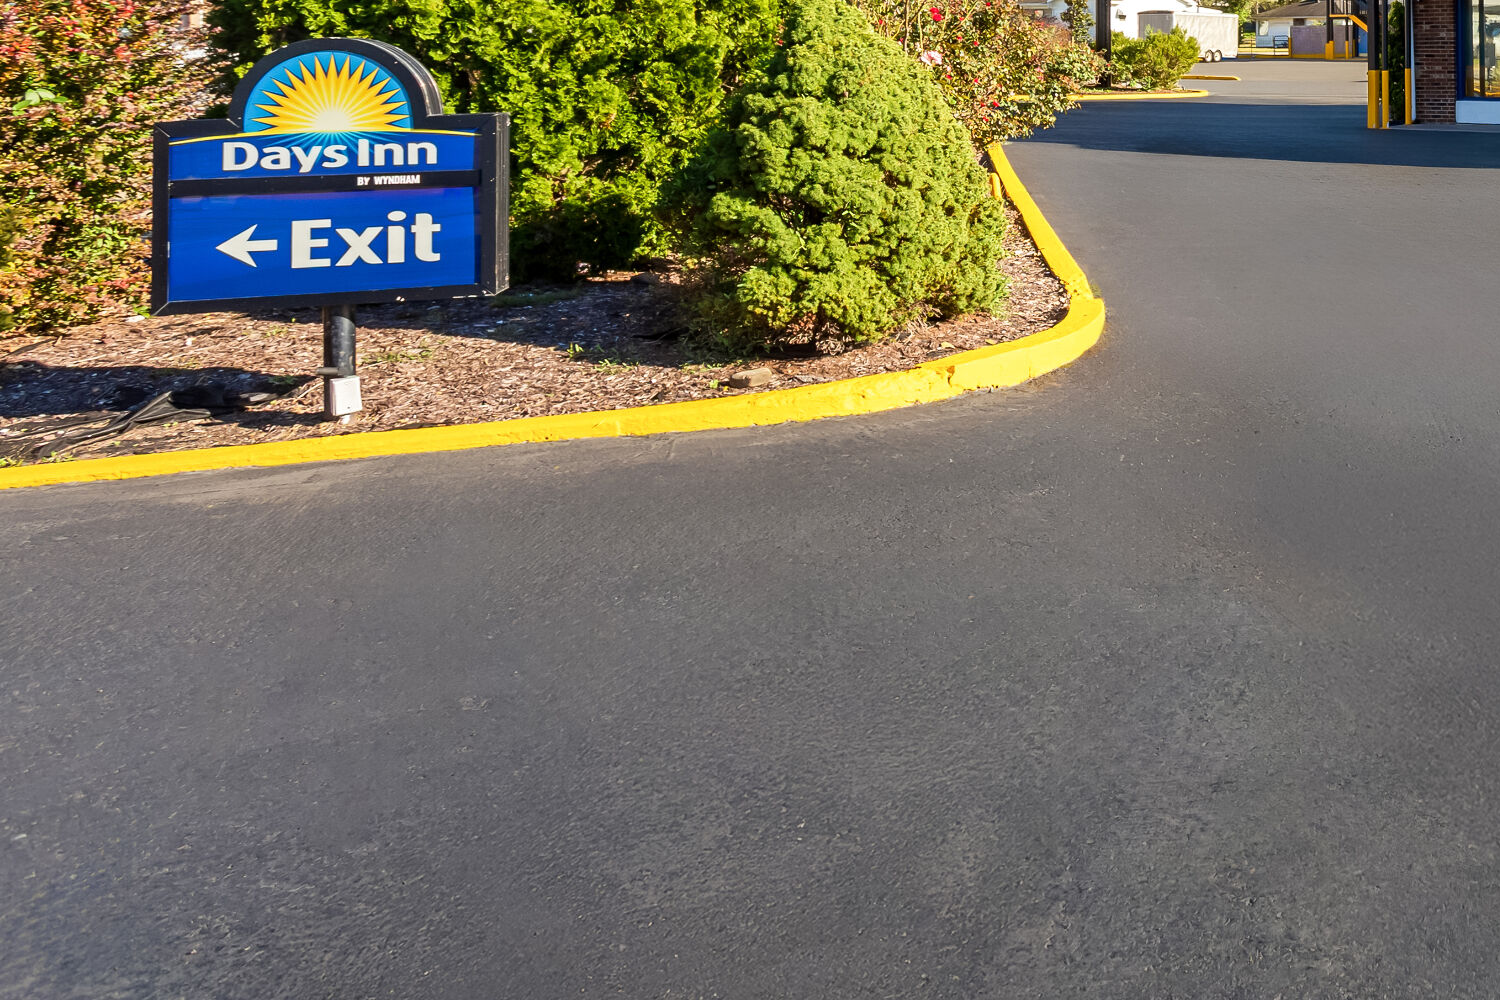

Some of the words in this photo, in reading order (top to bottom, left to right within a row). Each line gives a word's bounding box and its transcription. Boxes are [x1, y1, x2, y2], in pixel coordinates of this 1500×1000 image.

[222, 141, 349, 173] Days
[357, 138, 438, 167] Inn
[357, 176, 370, 186] BY
[374, 174, 421, 185] WYNDHAM
[291, 210, 441, 269] Exit
